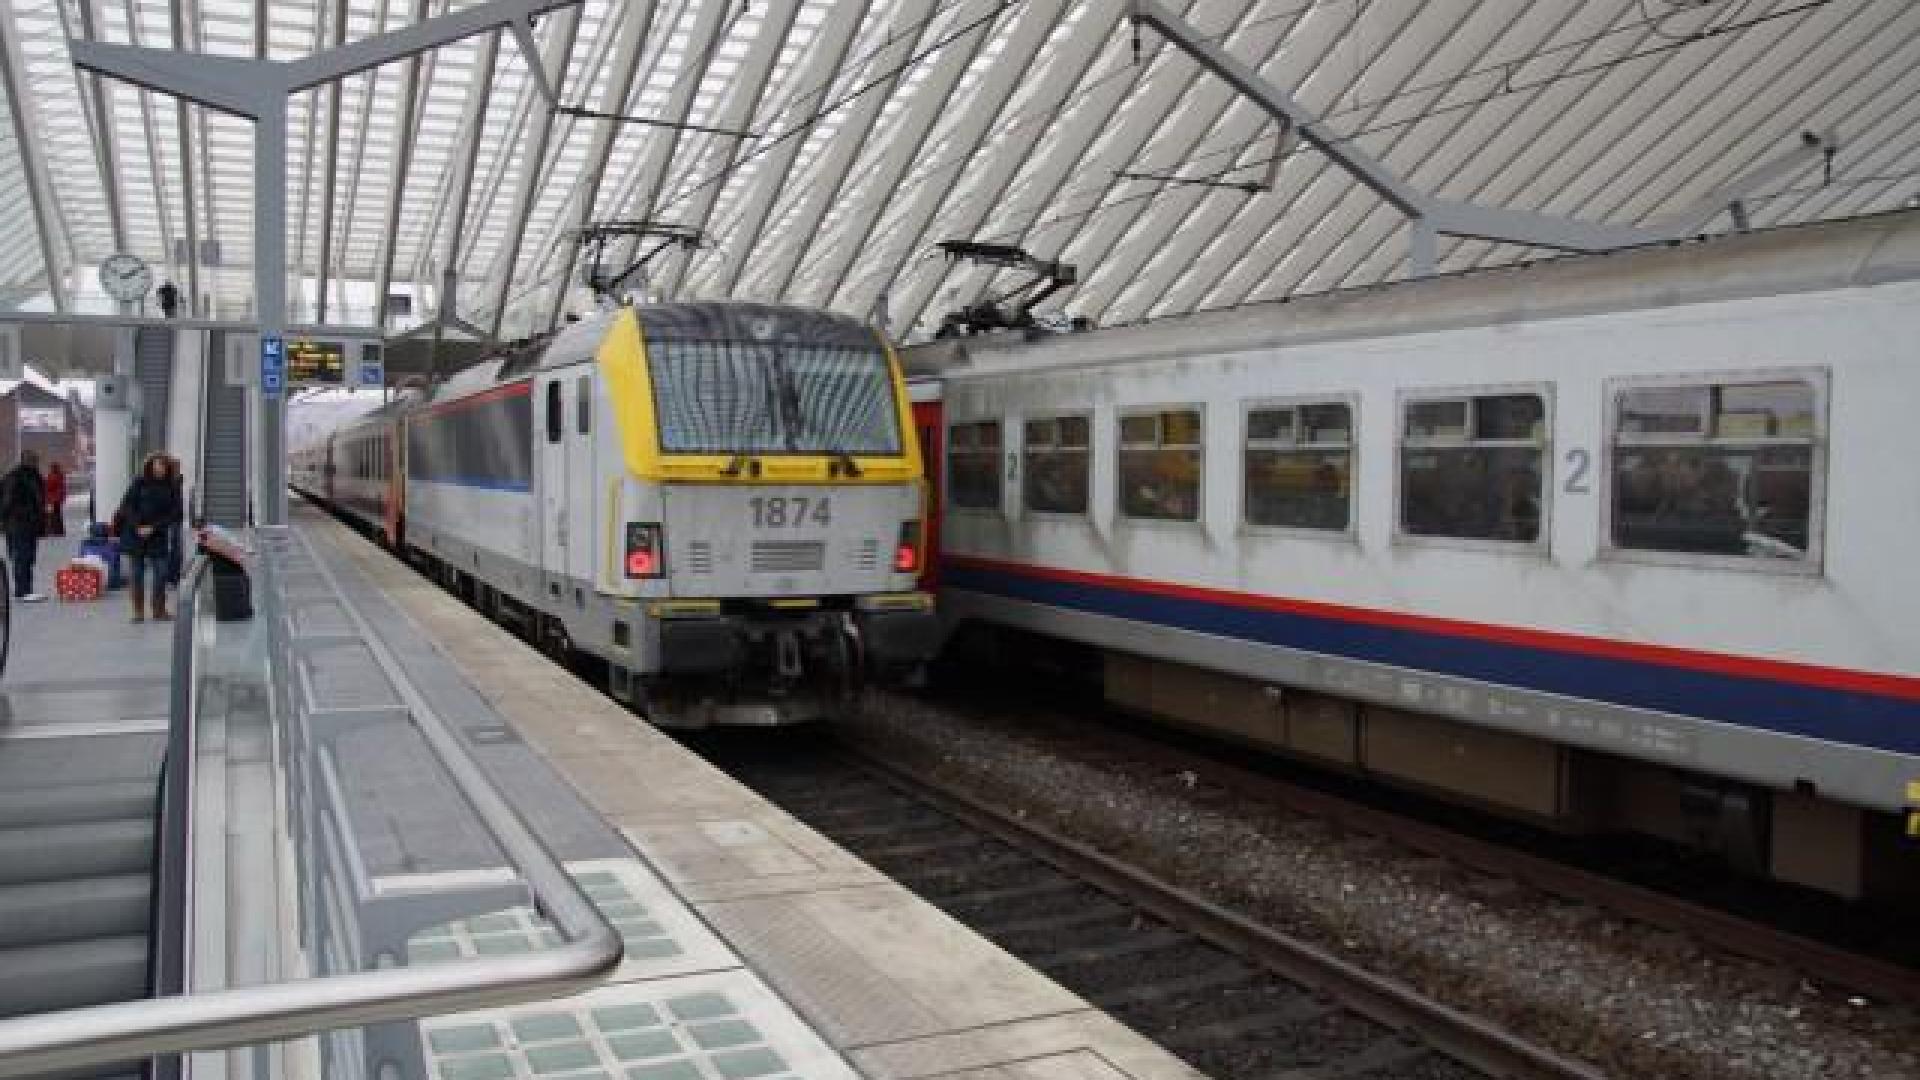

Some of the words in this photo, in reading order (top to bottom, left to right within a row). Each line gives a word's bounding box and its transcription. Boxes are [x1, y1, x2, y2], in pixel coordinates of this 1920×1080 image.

[1007, 449, 1018, 481] 2
[1564, 447, 1592, 494] 2
[749, 497, 832, 528] 1874
